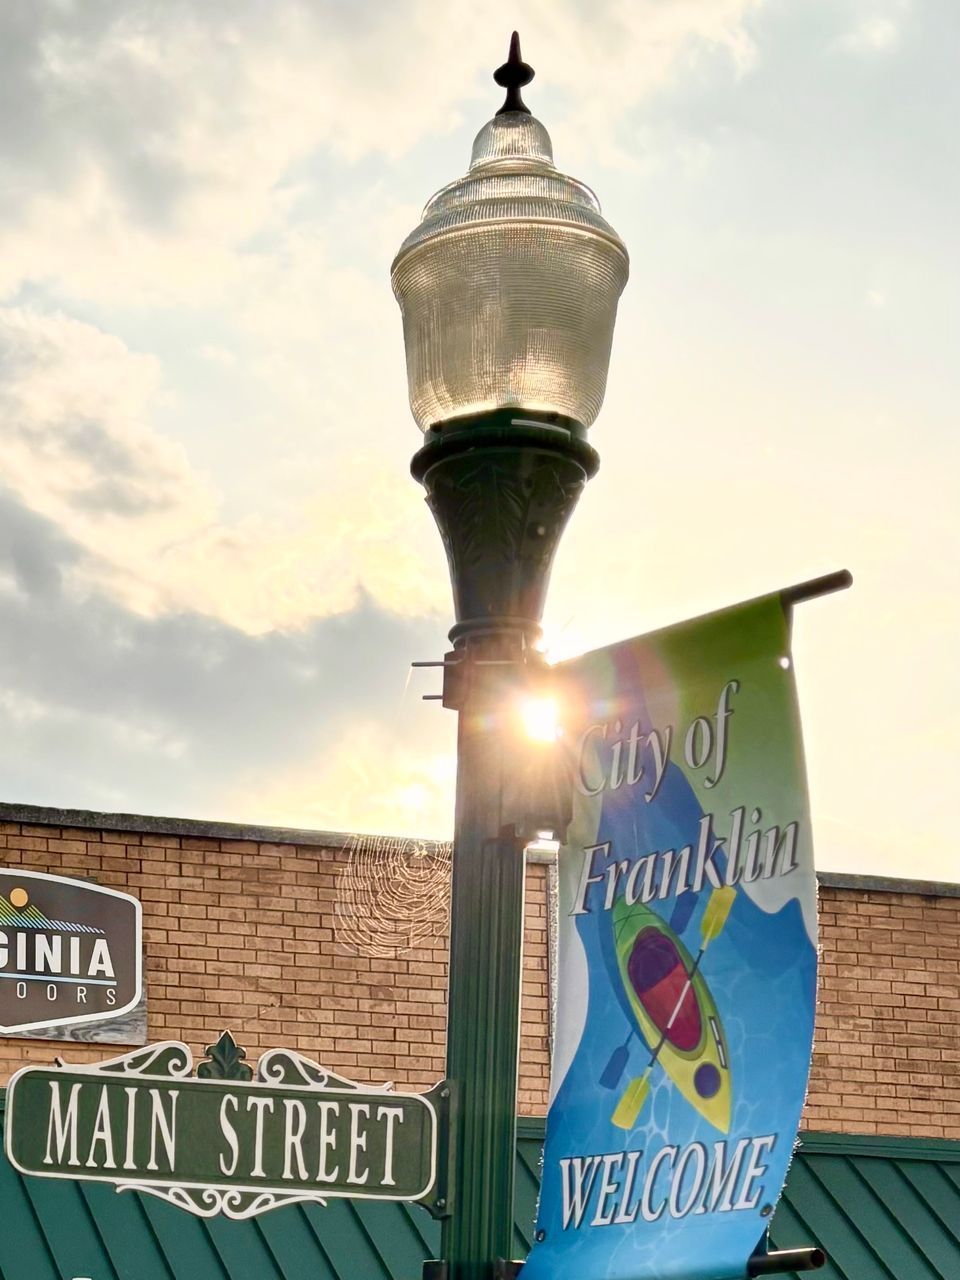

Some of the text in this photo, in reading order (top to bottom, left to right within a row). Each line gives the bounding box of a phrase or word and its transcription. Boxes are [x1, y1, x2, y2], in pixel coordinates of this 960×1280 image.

[577, 679, 740, 803] City of
[568, 805, 800, 917] Franklin
[42, 1080, 404, 1187] MAIN STREET
[559, 1132, 778, 1231] WELCOME
